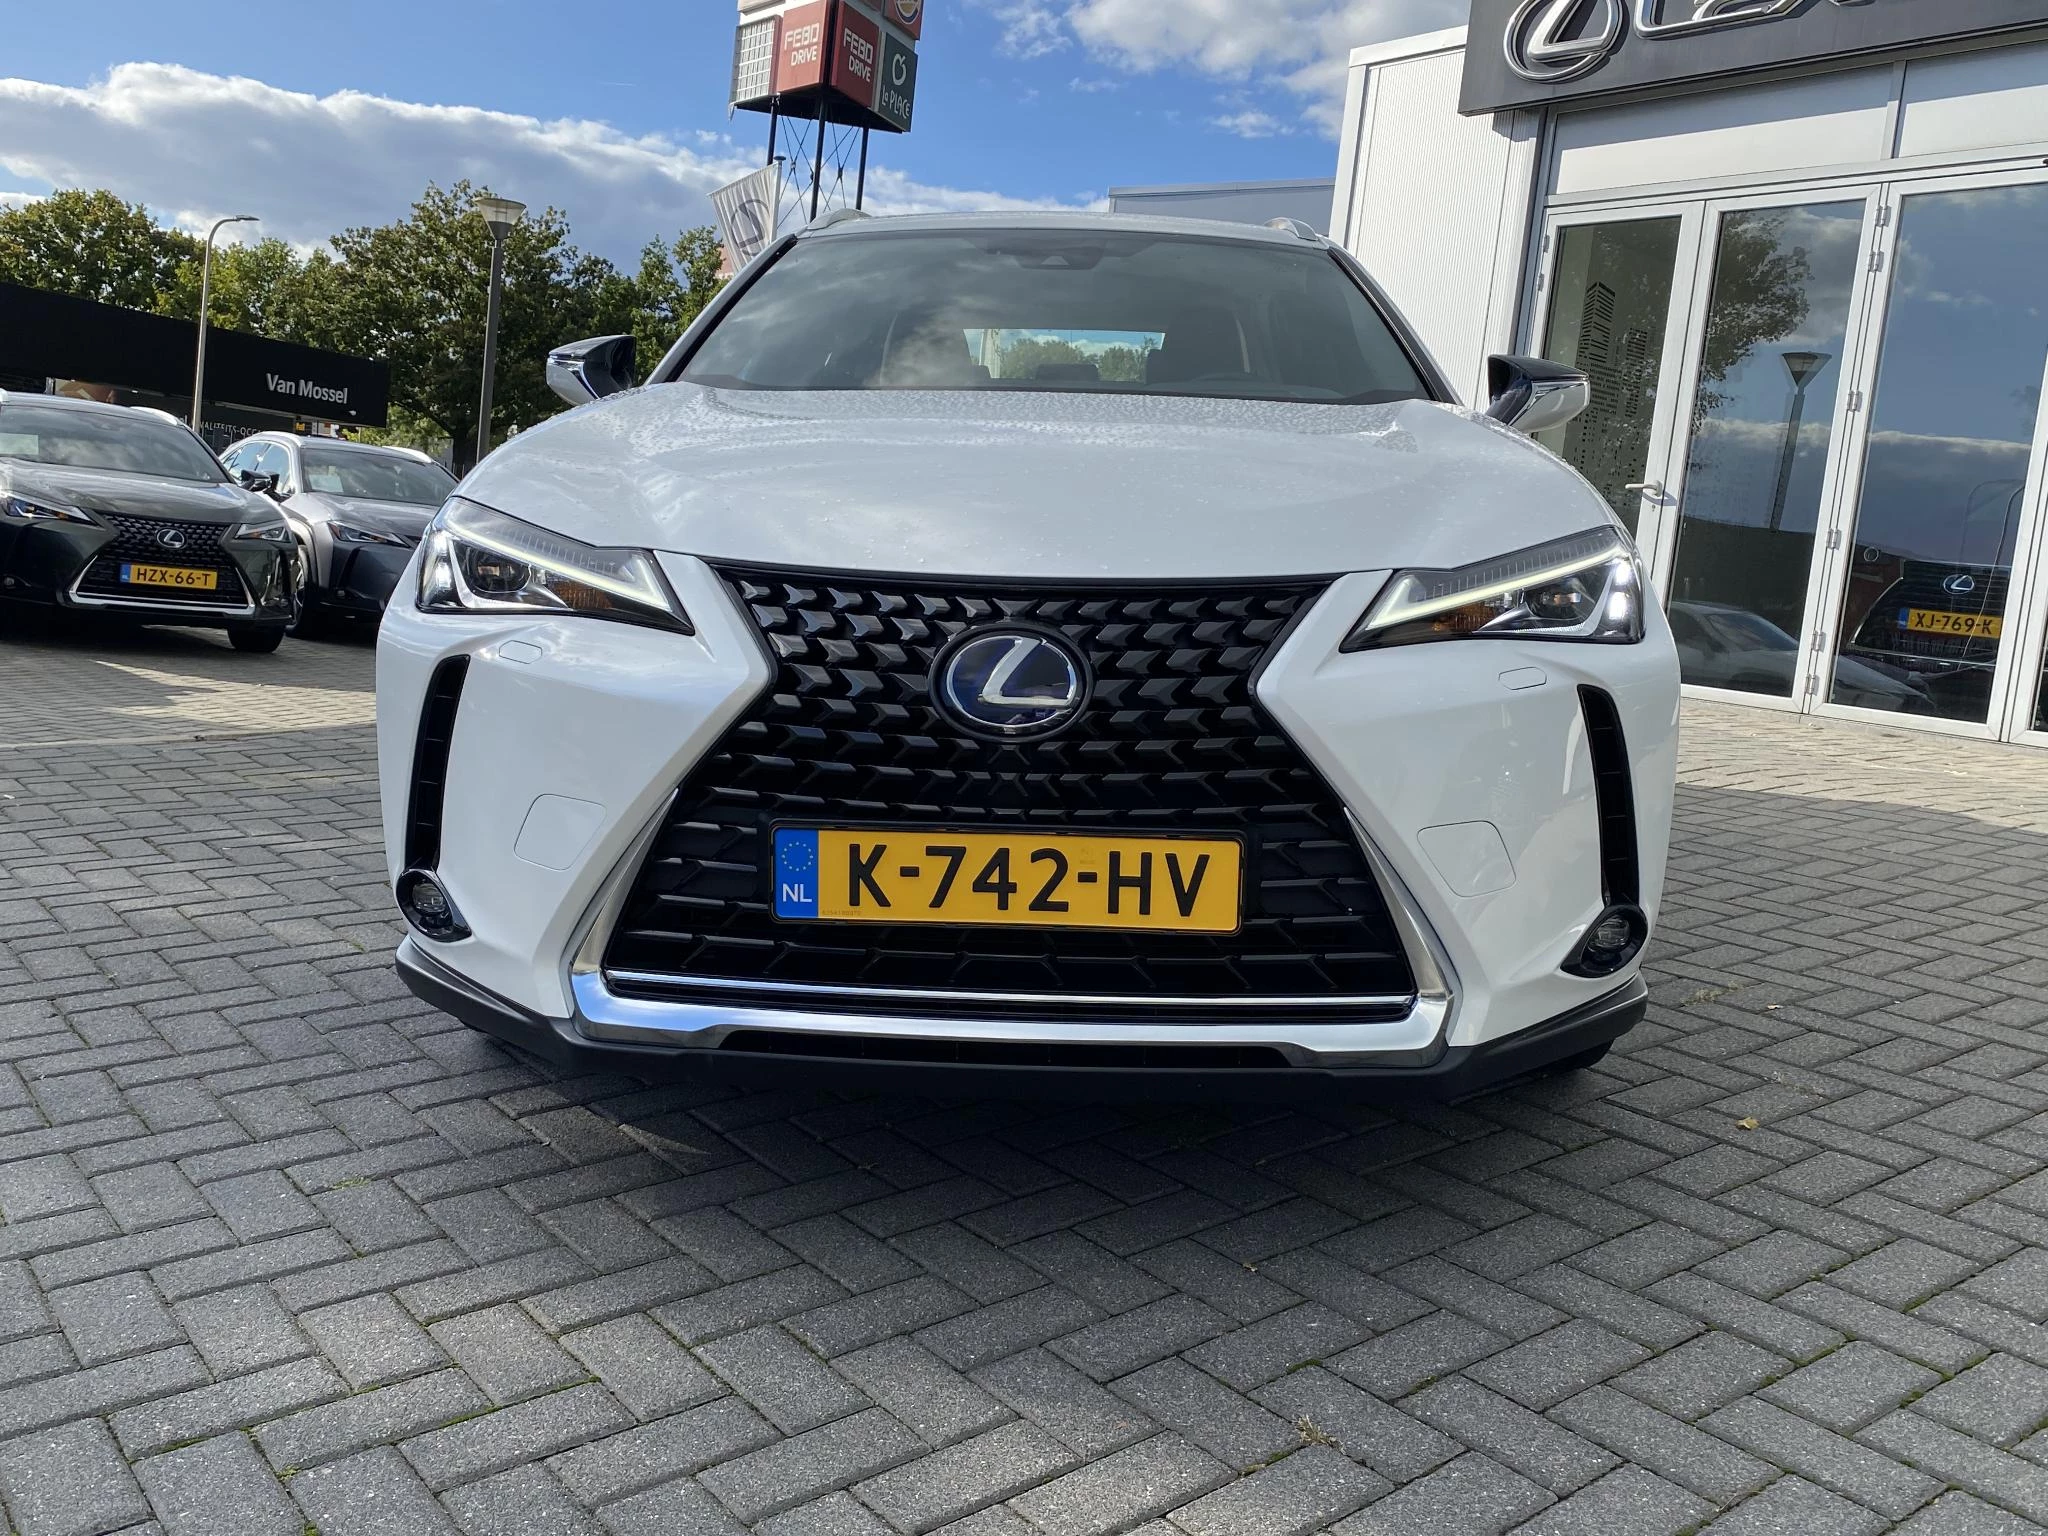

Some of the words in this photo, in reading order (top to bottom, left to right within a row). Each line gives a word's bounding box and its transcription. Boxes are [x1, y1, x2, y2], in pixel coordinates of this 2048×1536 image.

[784, 22, 820, 51] FEBO
[843, 27, 874, 65] FEBO
[790, 45, 818, 67] DRIVE
[848, 55, 872, 83] DRIVE
[889, 89, 911, 119] PLACE
[265, 372, 296, 395] Van
[298, 379, 349, 404] Mossel
[136, 567, 211, 586] HZX-66-T
[1914, 612, 1993, 635] XJ-769-K
[782, 883, 813, 903] NL
[848, 842, 1211, 917] K-742-HV
